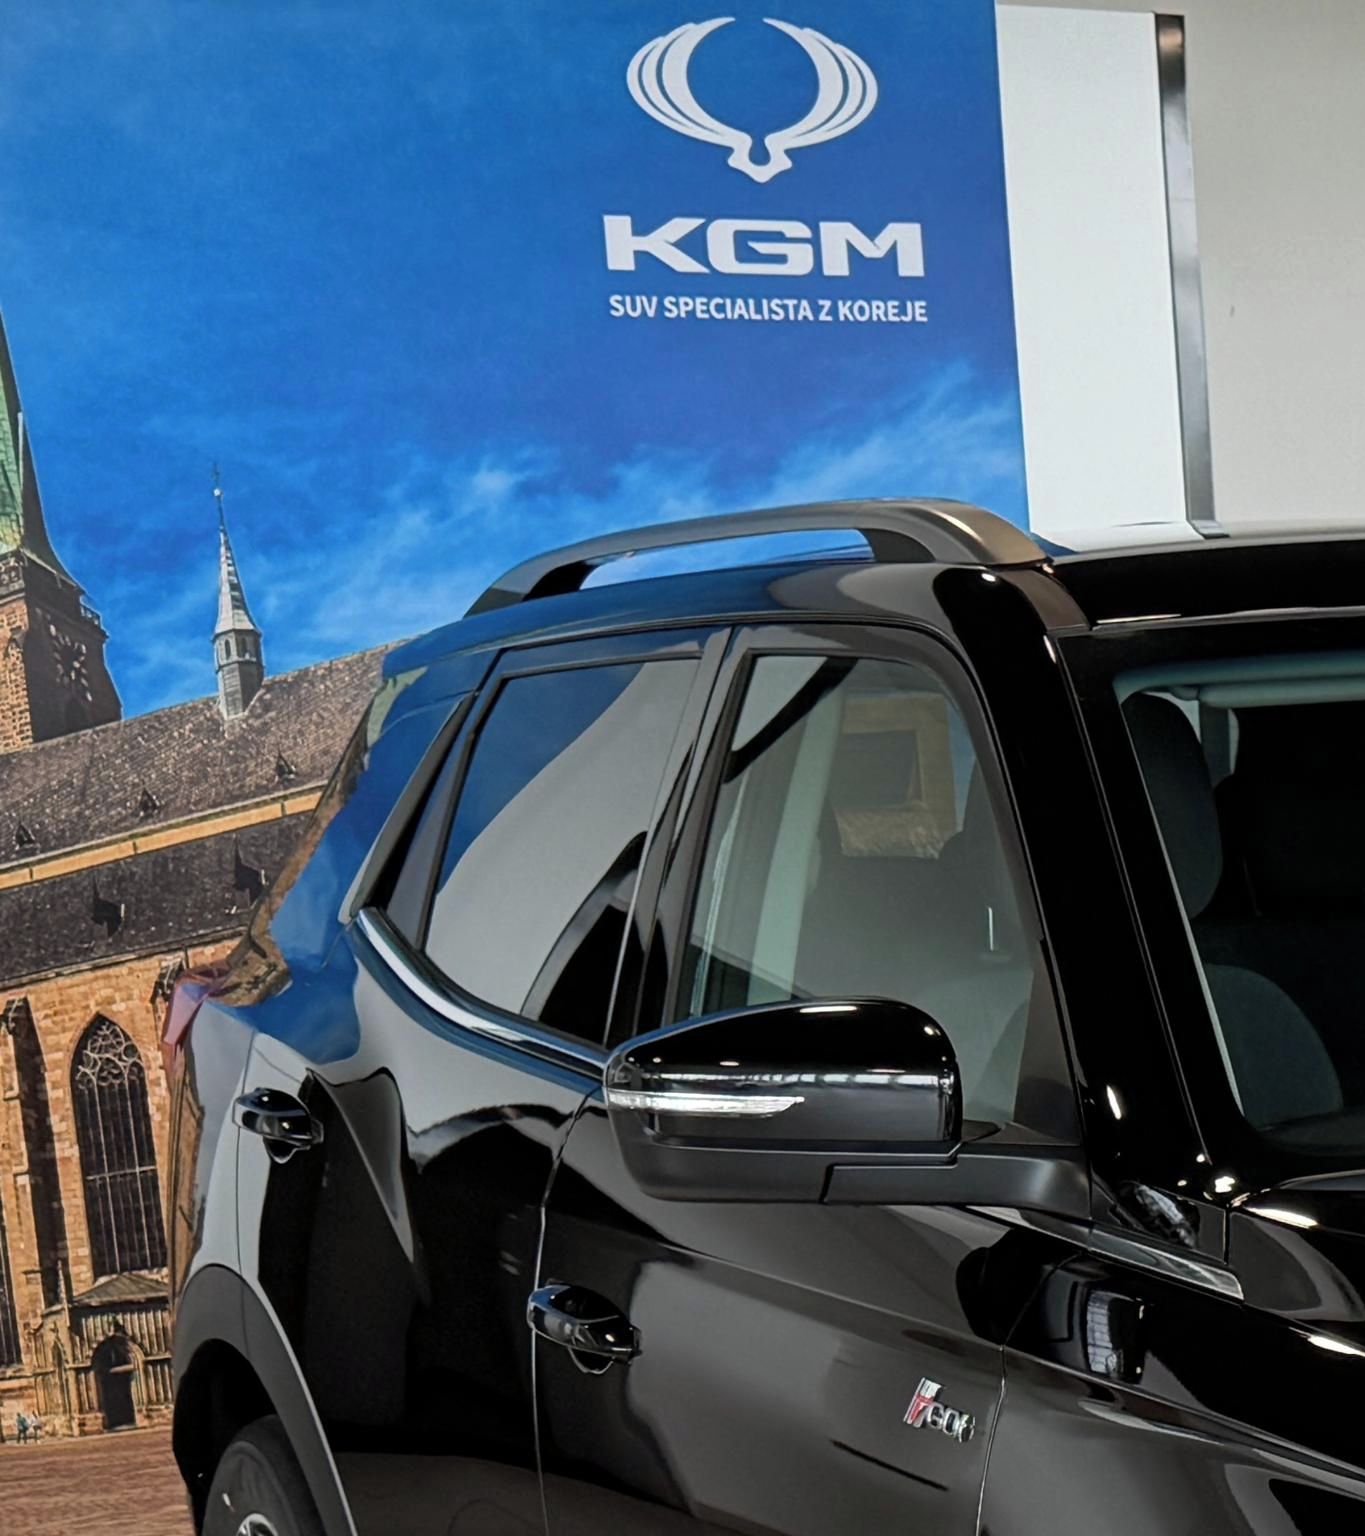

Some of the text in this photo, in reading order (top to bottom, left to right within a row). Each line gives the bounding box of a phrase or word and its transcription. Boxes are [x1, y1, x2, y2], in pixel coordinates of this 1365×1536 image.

[603, 215, 925, 277] KGM
[609, 295, 928, 322] SUV SPECIALISTA Z KOREJE
